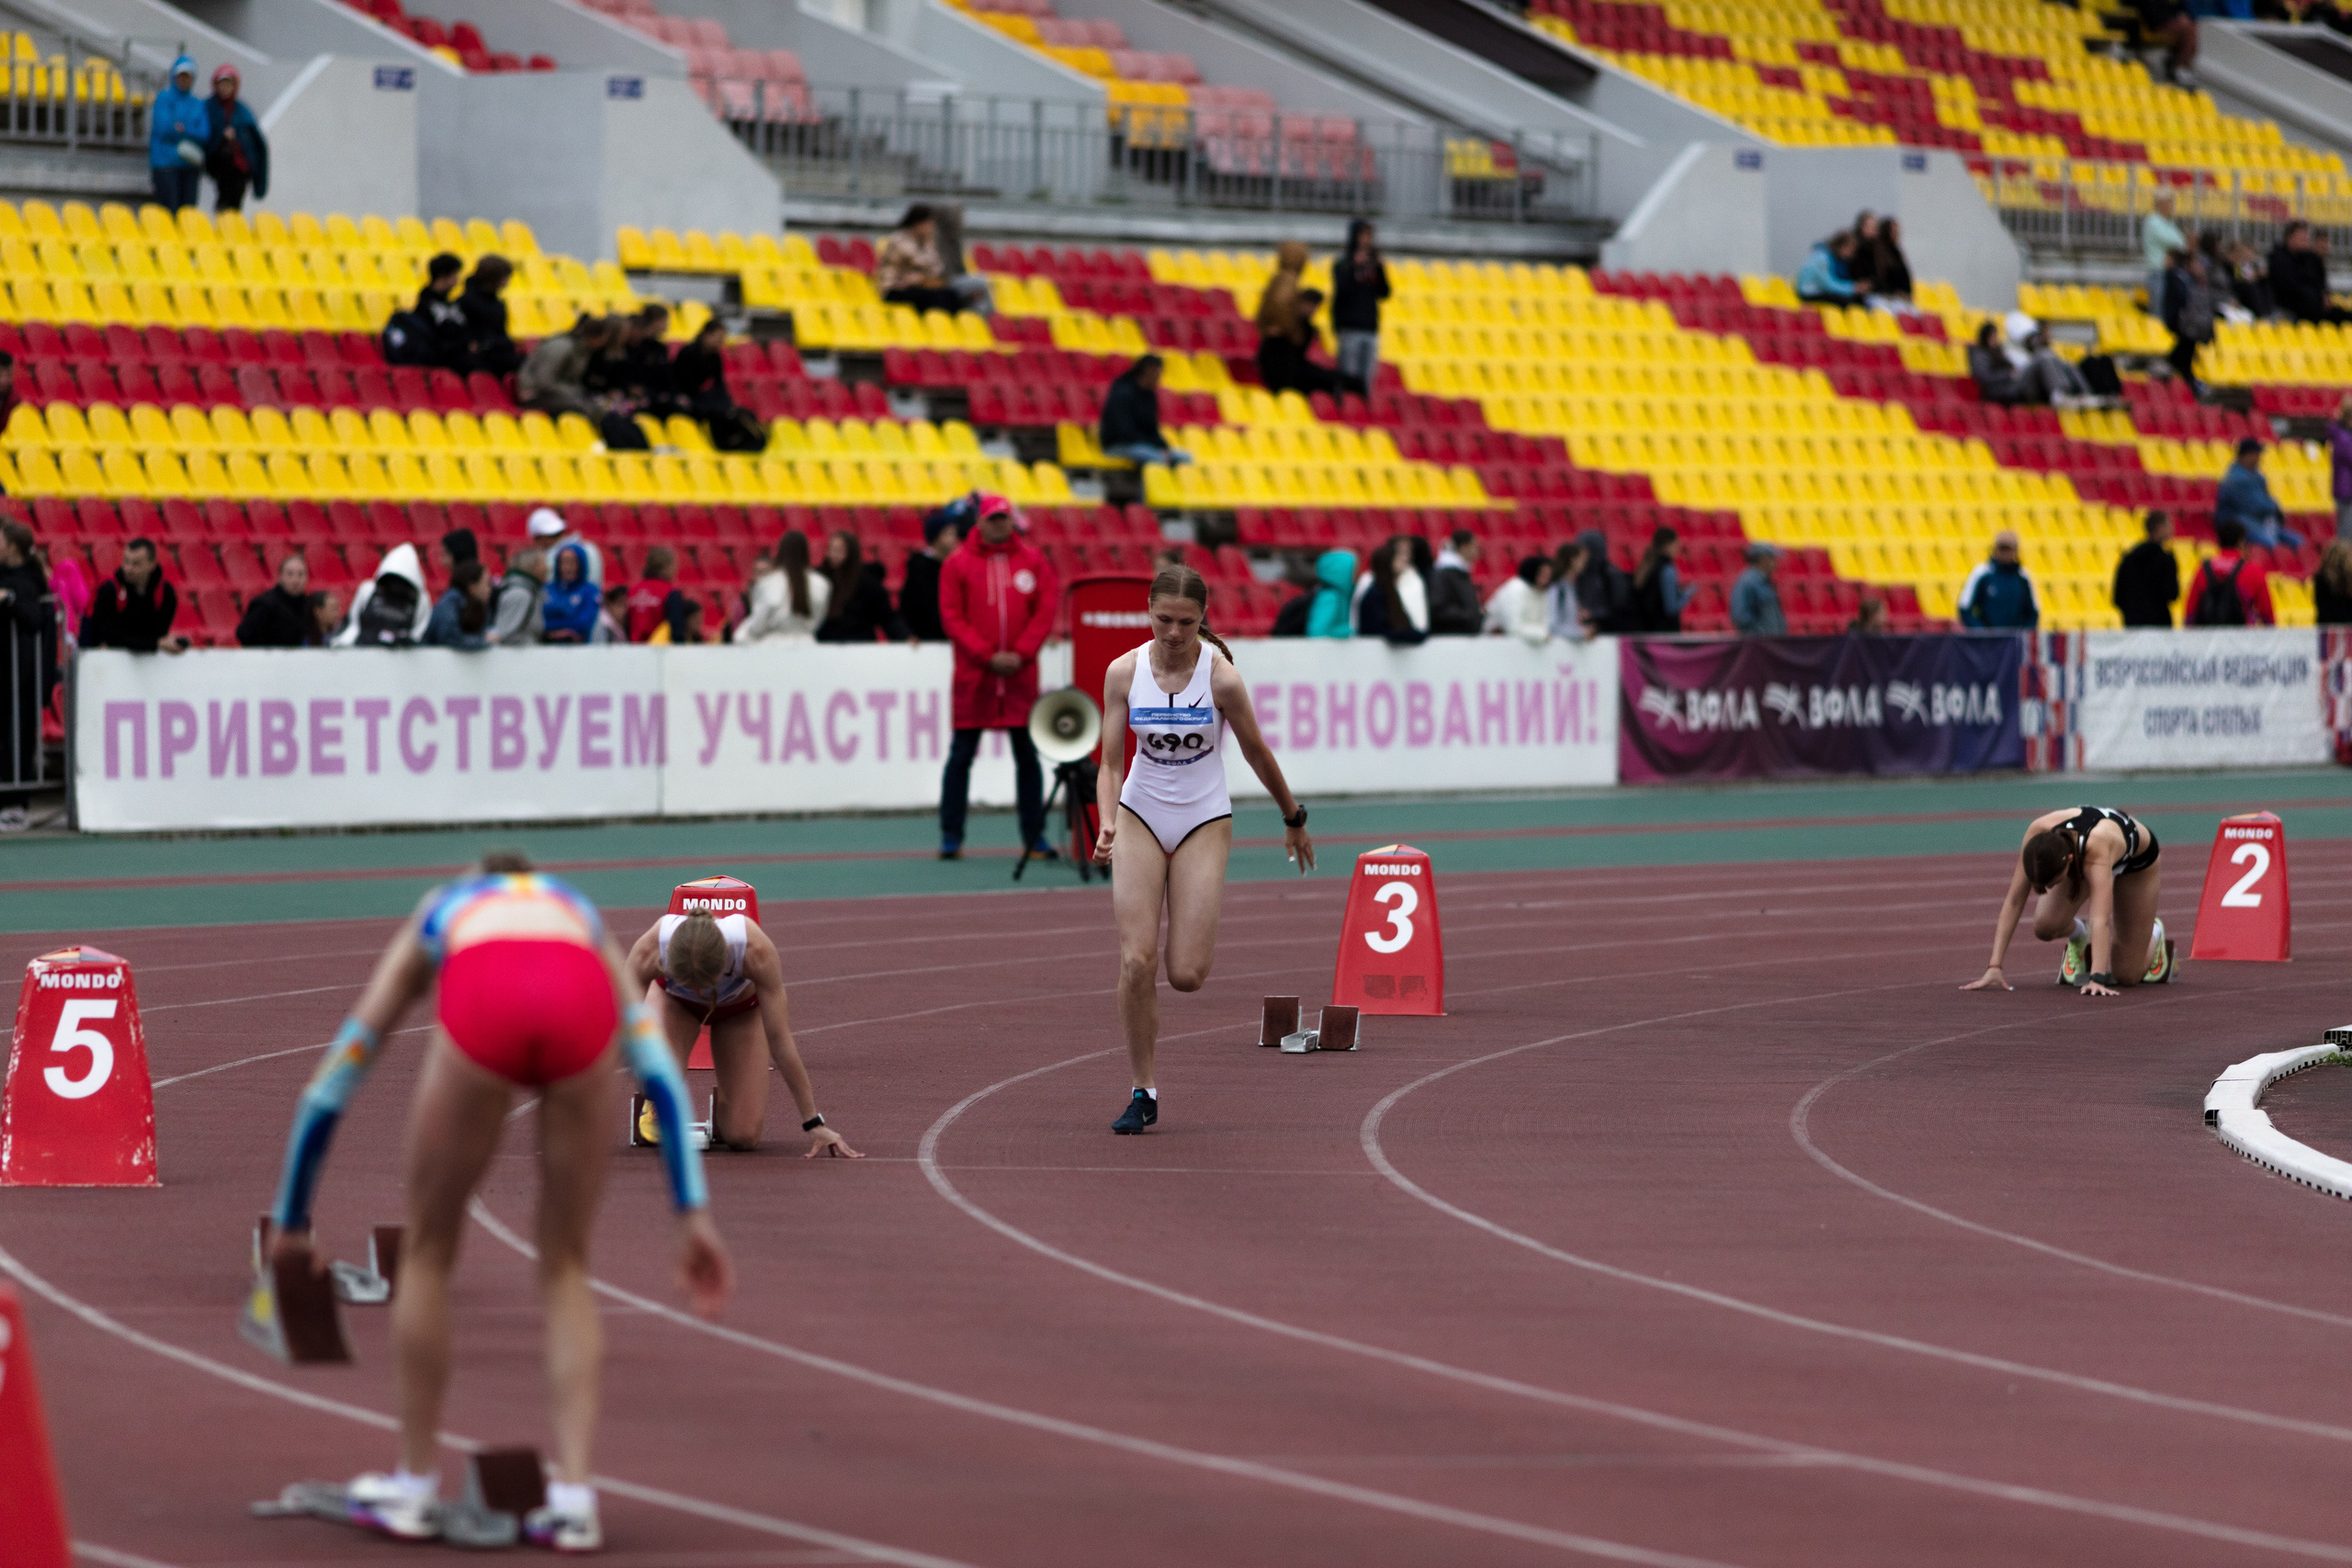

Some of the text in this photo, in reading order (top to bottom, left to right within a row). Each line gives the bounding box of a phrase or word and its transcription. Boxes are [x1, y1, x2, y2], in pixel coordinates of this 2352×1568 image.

[104, 663, 1599, 779] ПРИВЕТСТВУЕМ УЧАСТН ЕВНОВАНИЙ!
[1147, 733, 1204, 752] 490
[2224, 828, 2274, 840] MONDO
[1364, 864, 1421, 875] MONDO
[2221, 842, 2270, 908] 2
[683, 898, 746, 910] MONDO
[1364, 881, 1419, 953] 3
[40, 974, 120, 988] MONDO
[43, 998, 118, 1100] 5
